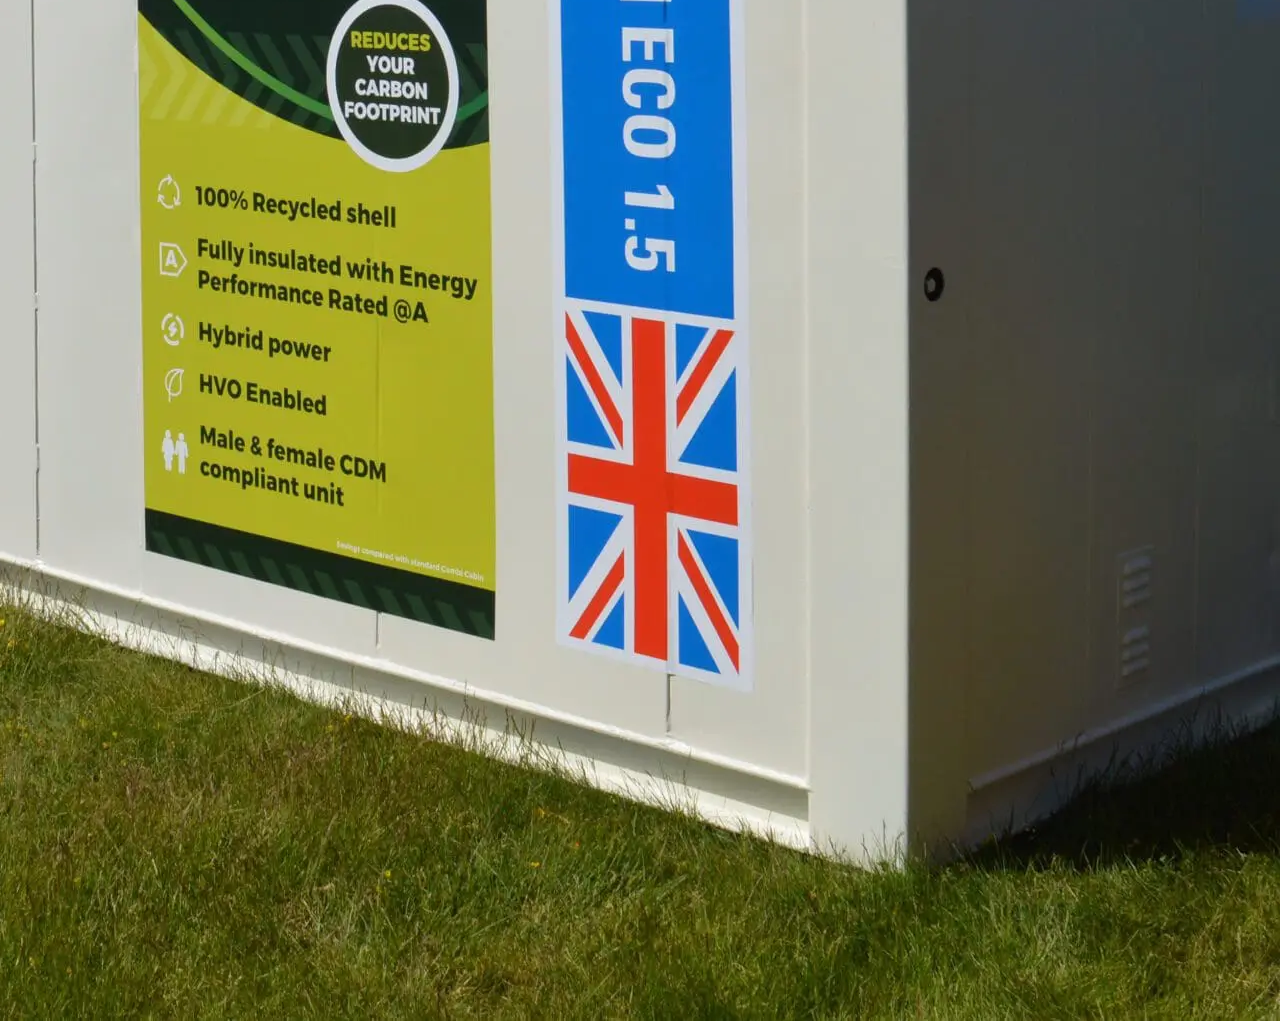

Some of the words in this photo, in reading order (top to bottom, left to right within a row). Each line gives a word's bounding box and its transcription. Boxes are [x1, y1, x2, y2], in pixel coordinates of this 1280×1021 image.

[351, 31, 431, 52] REDUCES
[366, 55, 415, 76] YOUR
[355, 78, 428, 100] CARBON
[622, 26, 676, 159] ECO
[344, 100, 441, 125] FOOTPRINT
[195, 185, 249, 210] 100%
[253, 192, 342, 223] Recycled
[346, 205, 397, 228] shell
[624, 184, 676, 272] 1.5
[197, 237, 245, 268] Fully
[249, 243, 342, 277] insulated
[347, 260, 395, 285] with
[400, 265, 478, 301] Energy
[198, 269, 324, 308] Performance
[328, 289, 389, 318] Rated
[393, 301, 429, 324] @A
[198, 322, 264, 352] Hybrid
[268, 338, 332, 362] power
[199, 374, 242, 399] HVO
[246, 383, 327, 416] Enabled
[199, 426, 246, 453] Male
[250, 438, 263, 457] &
[267, 438, 336, 470] female
[340, 454, 387, 482] CDM
[199, 460, 299, 498] compliant
[303, 480, 345, 506] unit
